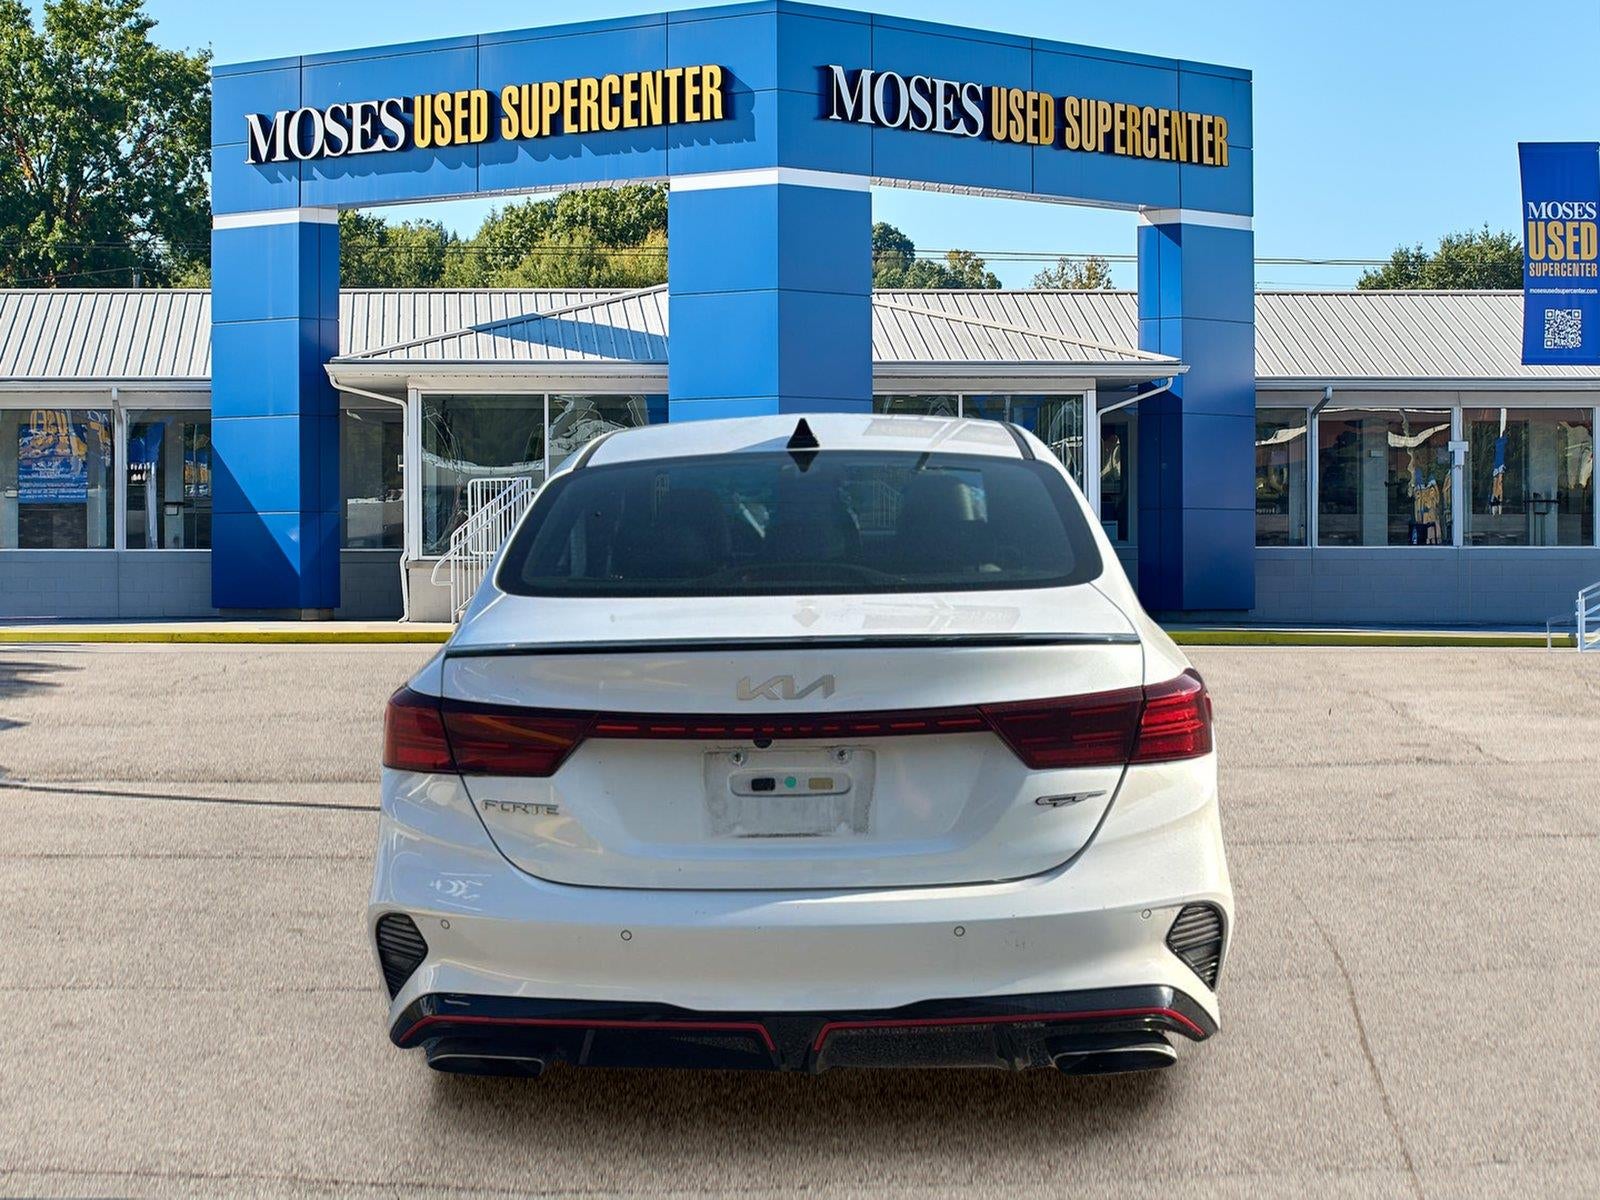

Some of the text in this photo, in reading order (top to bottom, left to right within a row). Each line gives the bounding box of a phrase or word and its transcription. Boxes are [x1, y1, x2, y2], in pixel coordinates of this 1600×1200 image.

[245, 64, 724, 164] MOSES USED SUPERCENTER
[828, 65, 1230, 167] MOSES USED SUPERCENTER
[1527, 201, 1597, 219] MOSES
[1528, 221, 1597, 260] USED
[1529, 262, 1598, 277] SUPERCENTER
[736, 674, 835, 701] KIA
[482, 799, 560, 815] FORTE
